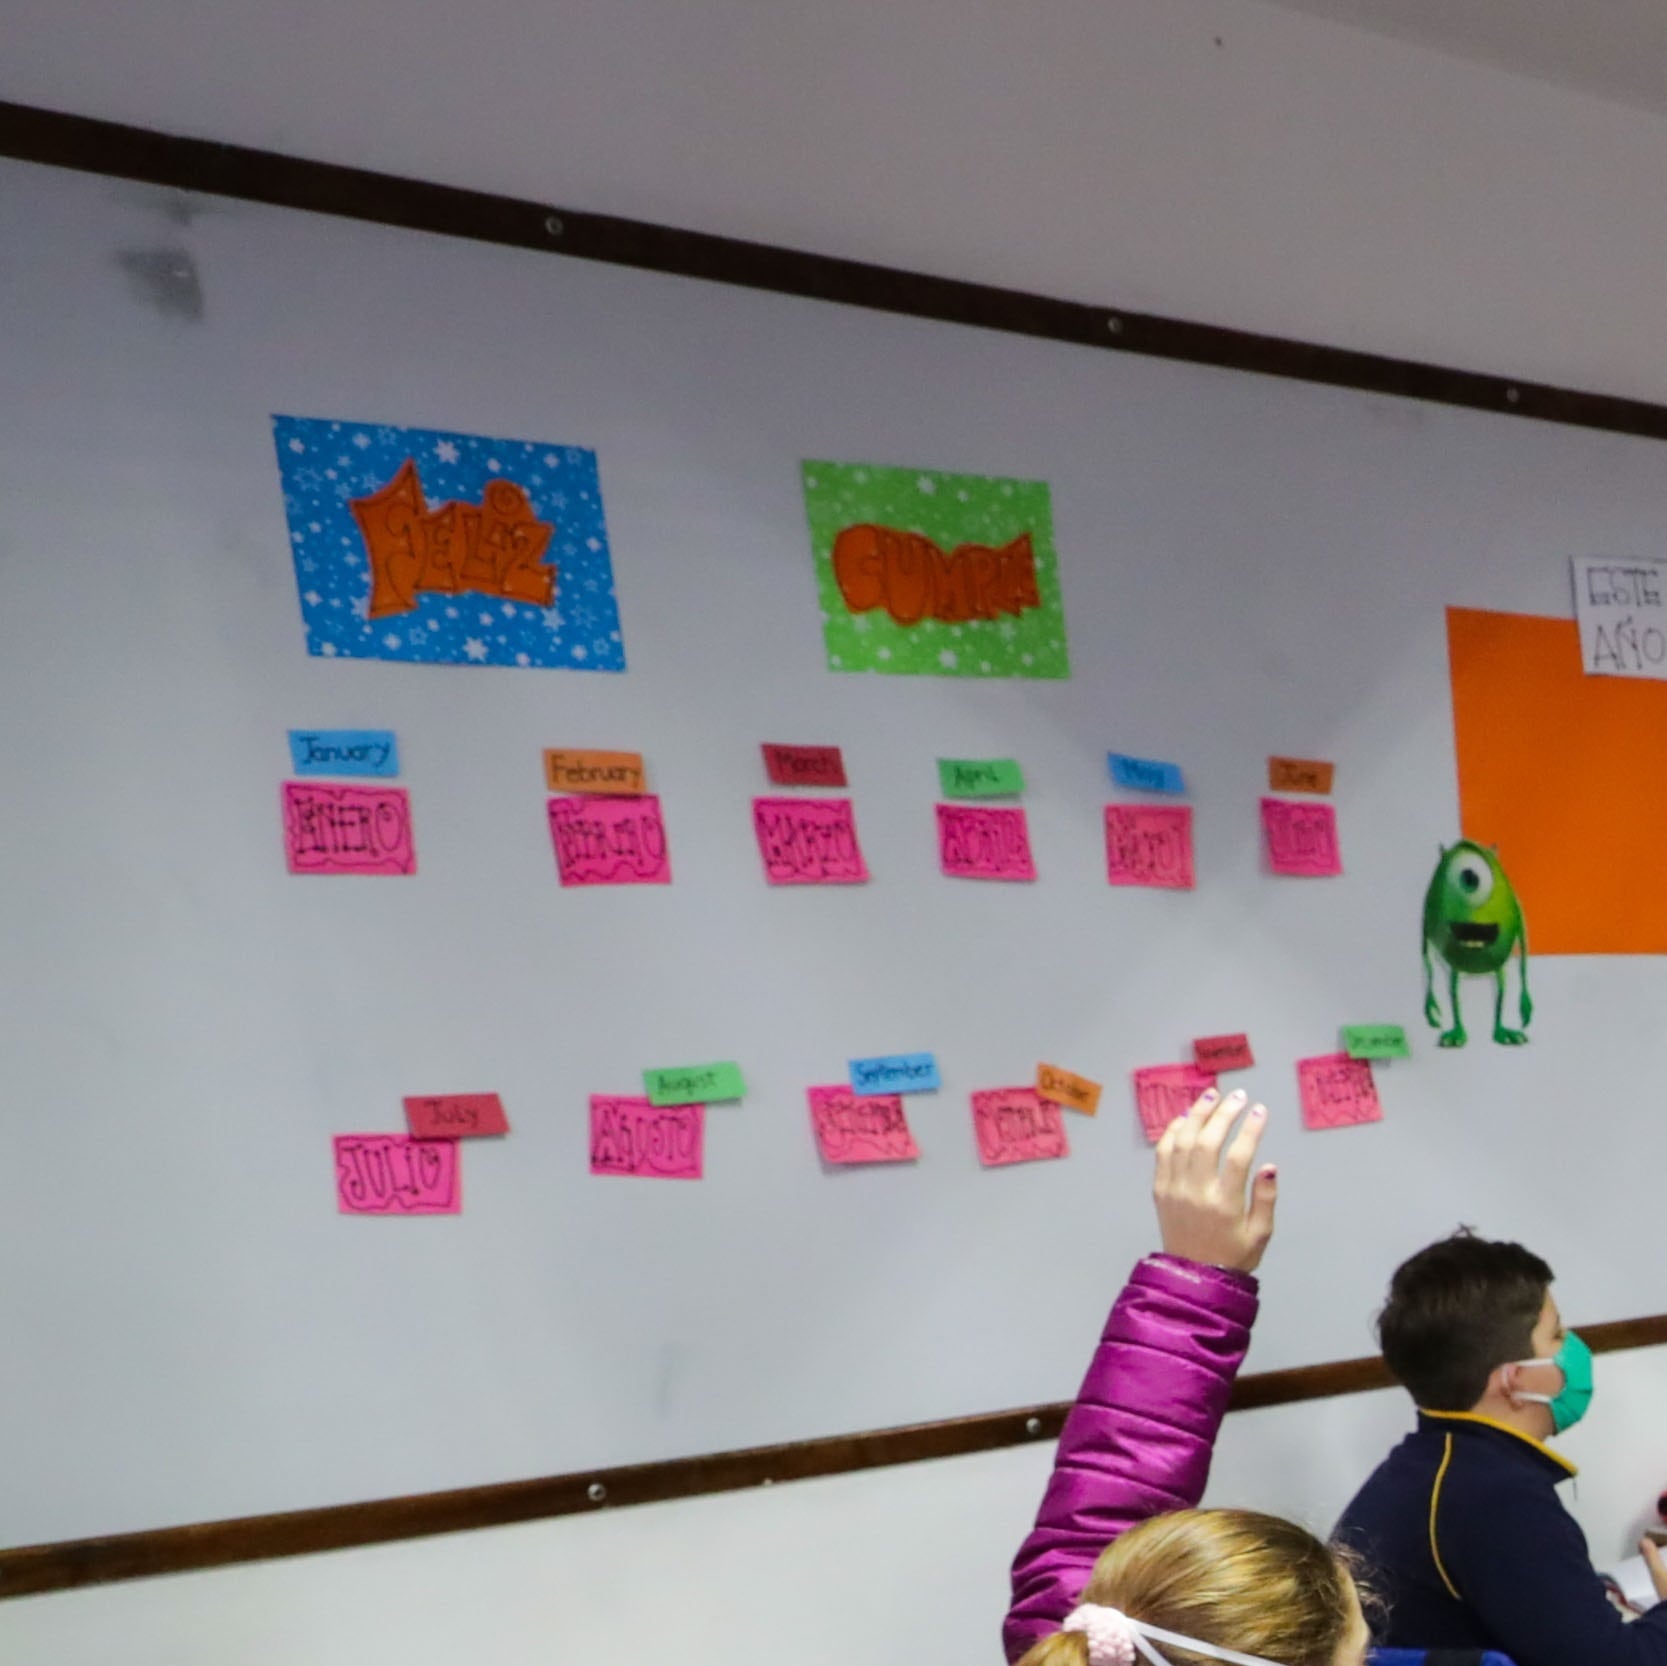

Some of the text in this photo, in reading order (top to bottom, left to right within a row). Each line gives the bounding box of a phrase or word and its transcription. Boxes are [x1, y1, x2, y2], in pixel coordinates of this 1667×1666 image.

[1586, 566, 1661, 607] ESTE
[299, 735, 390, 768] January
[551, 754, 642, 788] February
[294, 797, 401, 857] ENERO
[344, 1143, 441, 1200] JULIO
